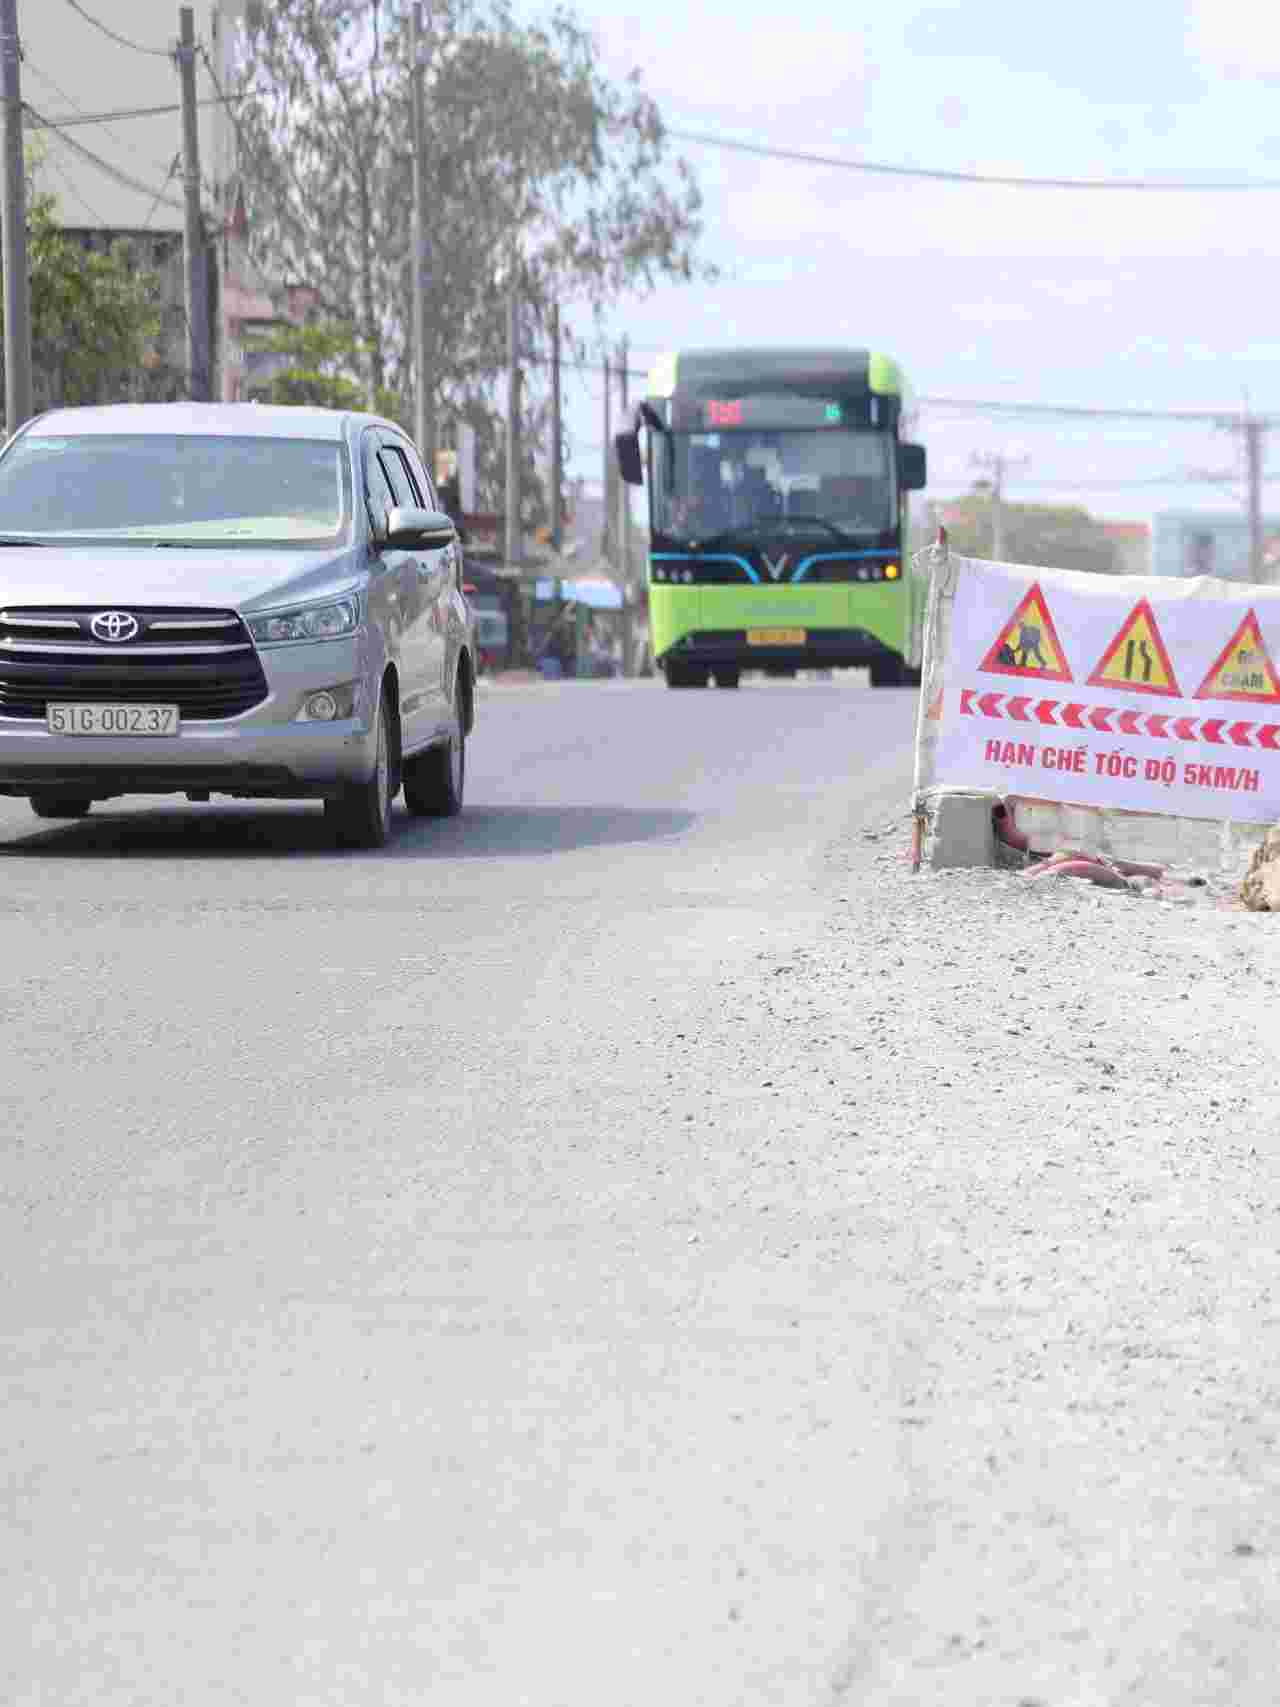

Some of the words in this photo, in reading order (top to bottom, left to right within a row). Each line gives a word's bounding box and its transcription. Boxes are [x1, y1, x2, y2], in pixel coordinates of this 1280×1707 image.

[984, 738, 1035, 769] HẠN
[1040, 744, 1088, 774] CHẾ
[1094, 746, 1138, 779] TỐC
[1144, 755, 1177, 788] ĐỘ
[1183, 762, 1260, 793] 5KM/H
